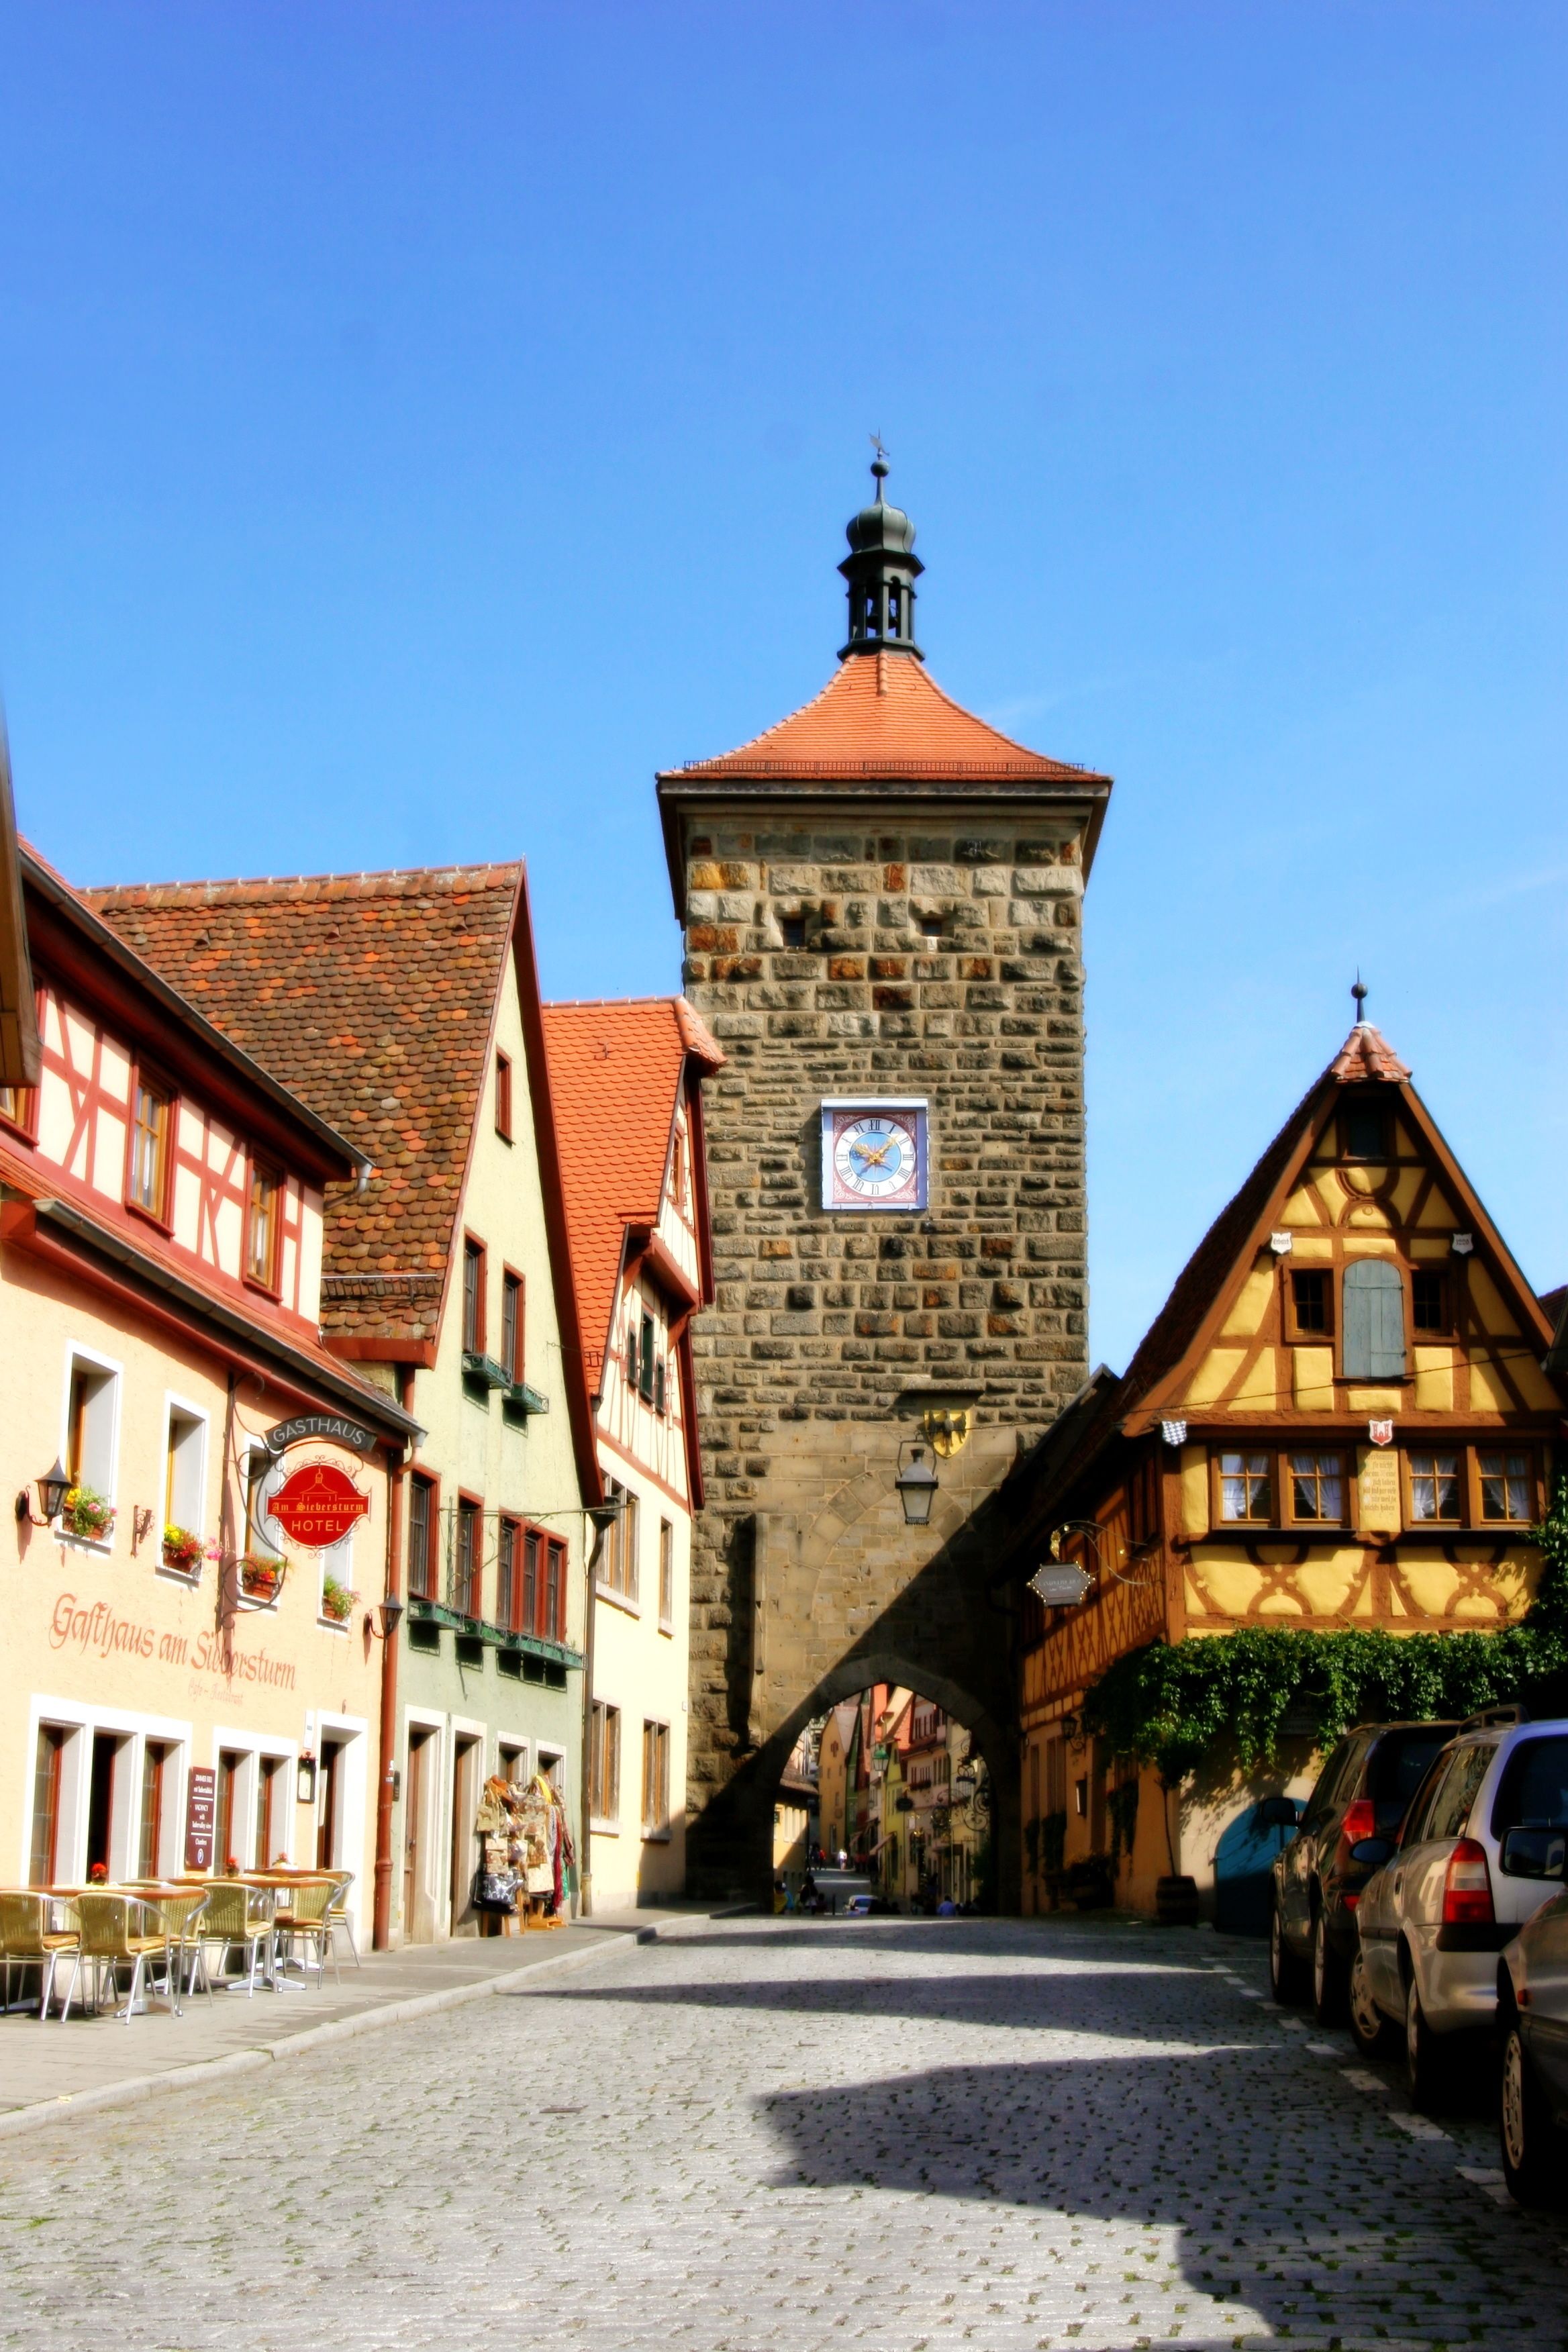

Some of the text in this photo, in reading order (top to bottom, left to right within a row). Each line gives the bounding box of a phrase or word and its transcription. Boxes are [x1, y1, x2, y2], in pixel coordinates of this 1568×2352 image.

[273, 1418, 366, 1444] GASTHAUS
[272, 1502, 364, 1512] Am Siebersturm
[291, 1520, 344, 1531] HOTEL
[49, 1593, 297, 1691] Gasthaus am Siebersturm
[342, 1699, 346, 1714] 6
